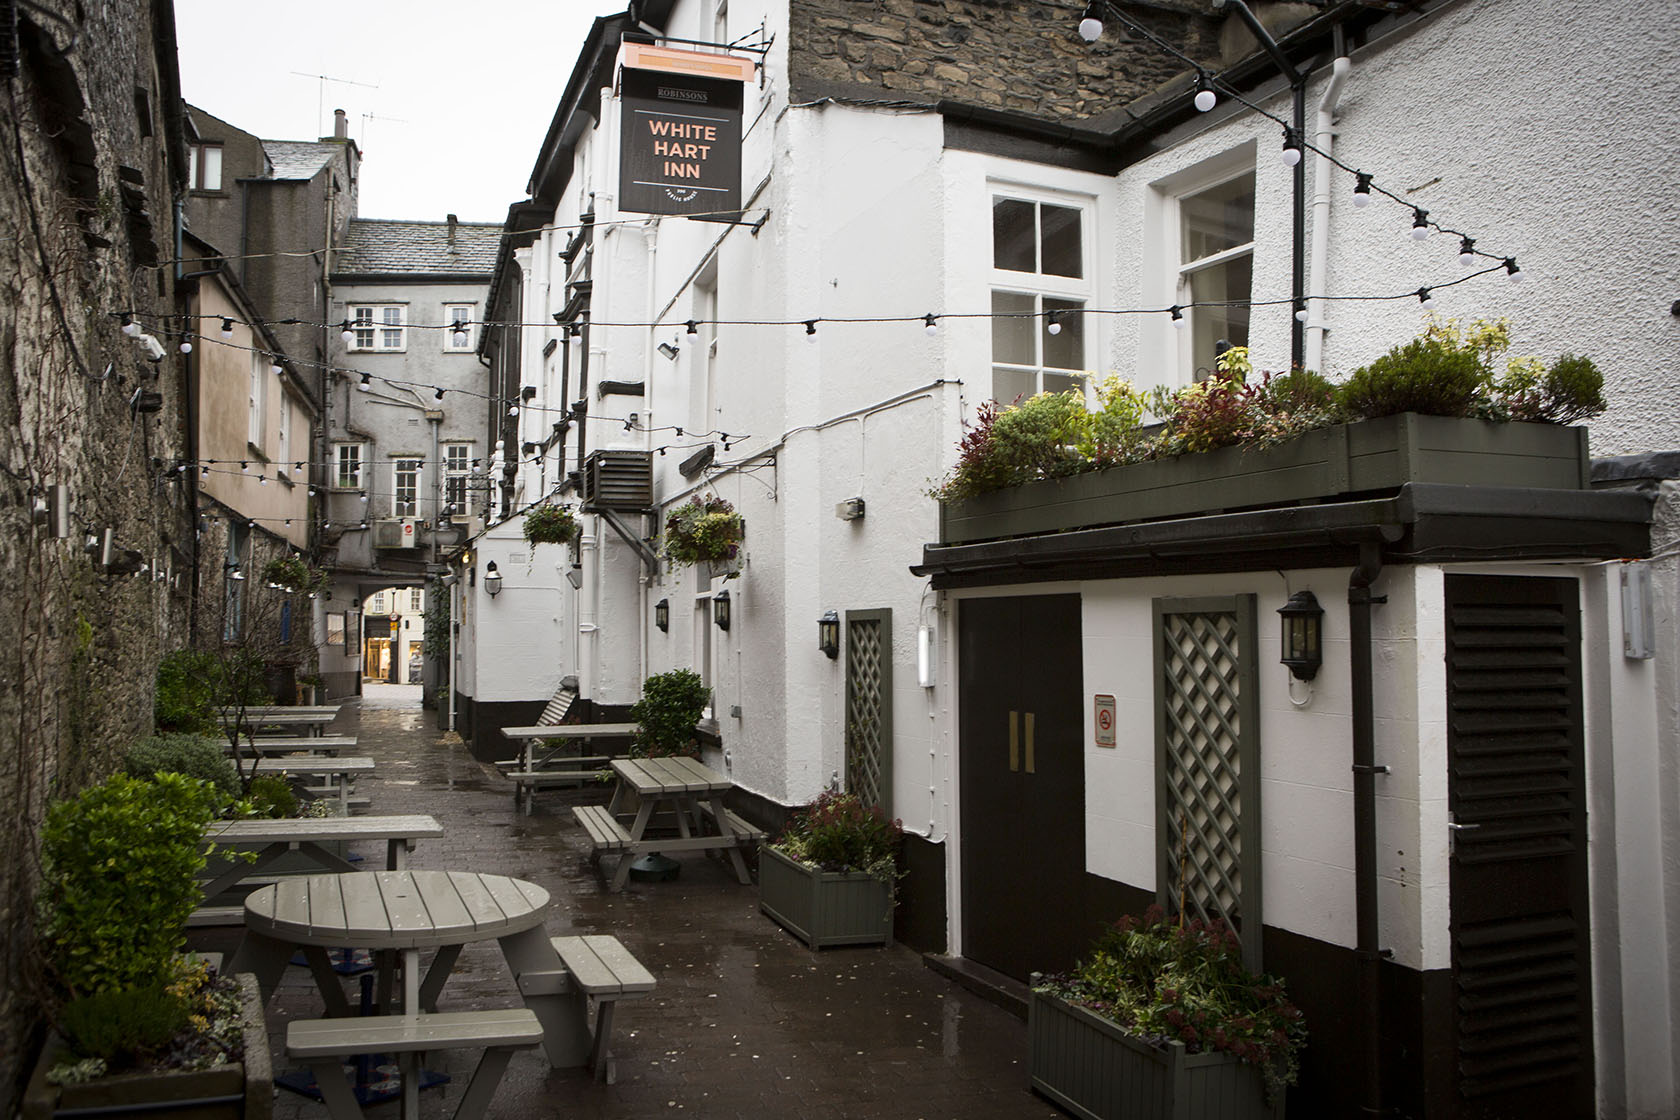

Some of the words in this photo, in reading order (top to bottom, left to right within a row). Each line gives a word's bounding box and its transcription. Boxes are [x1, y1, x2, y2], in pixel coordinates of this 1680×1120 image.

[657, 88, 708, 100] ROBINSONS
[648, 119, 717, 141] WHITE
[654, 140, 711, 160] HART
[664, 161, 700, 179] INN
